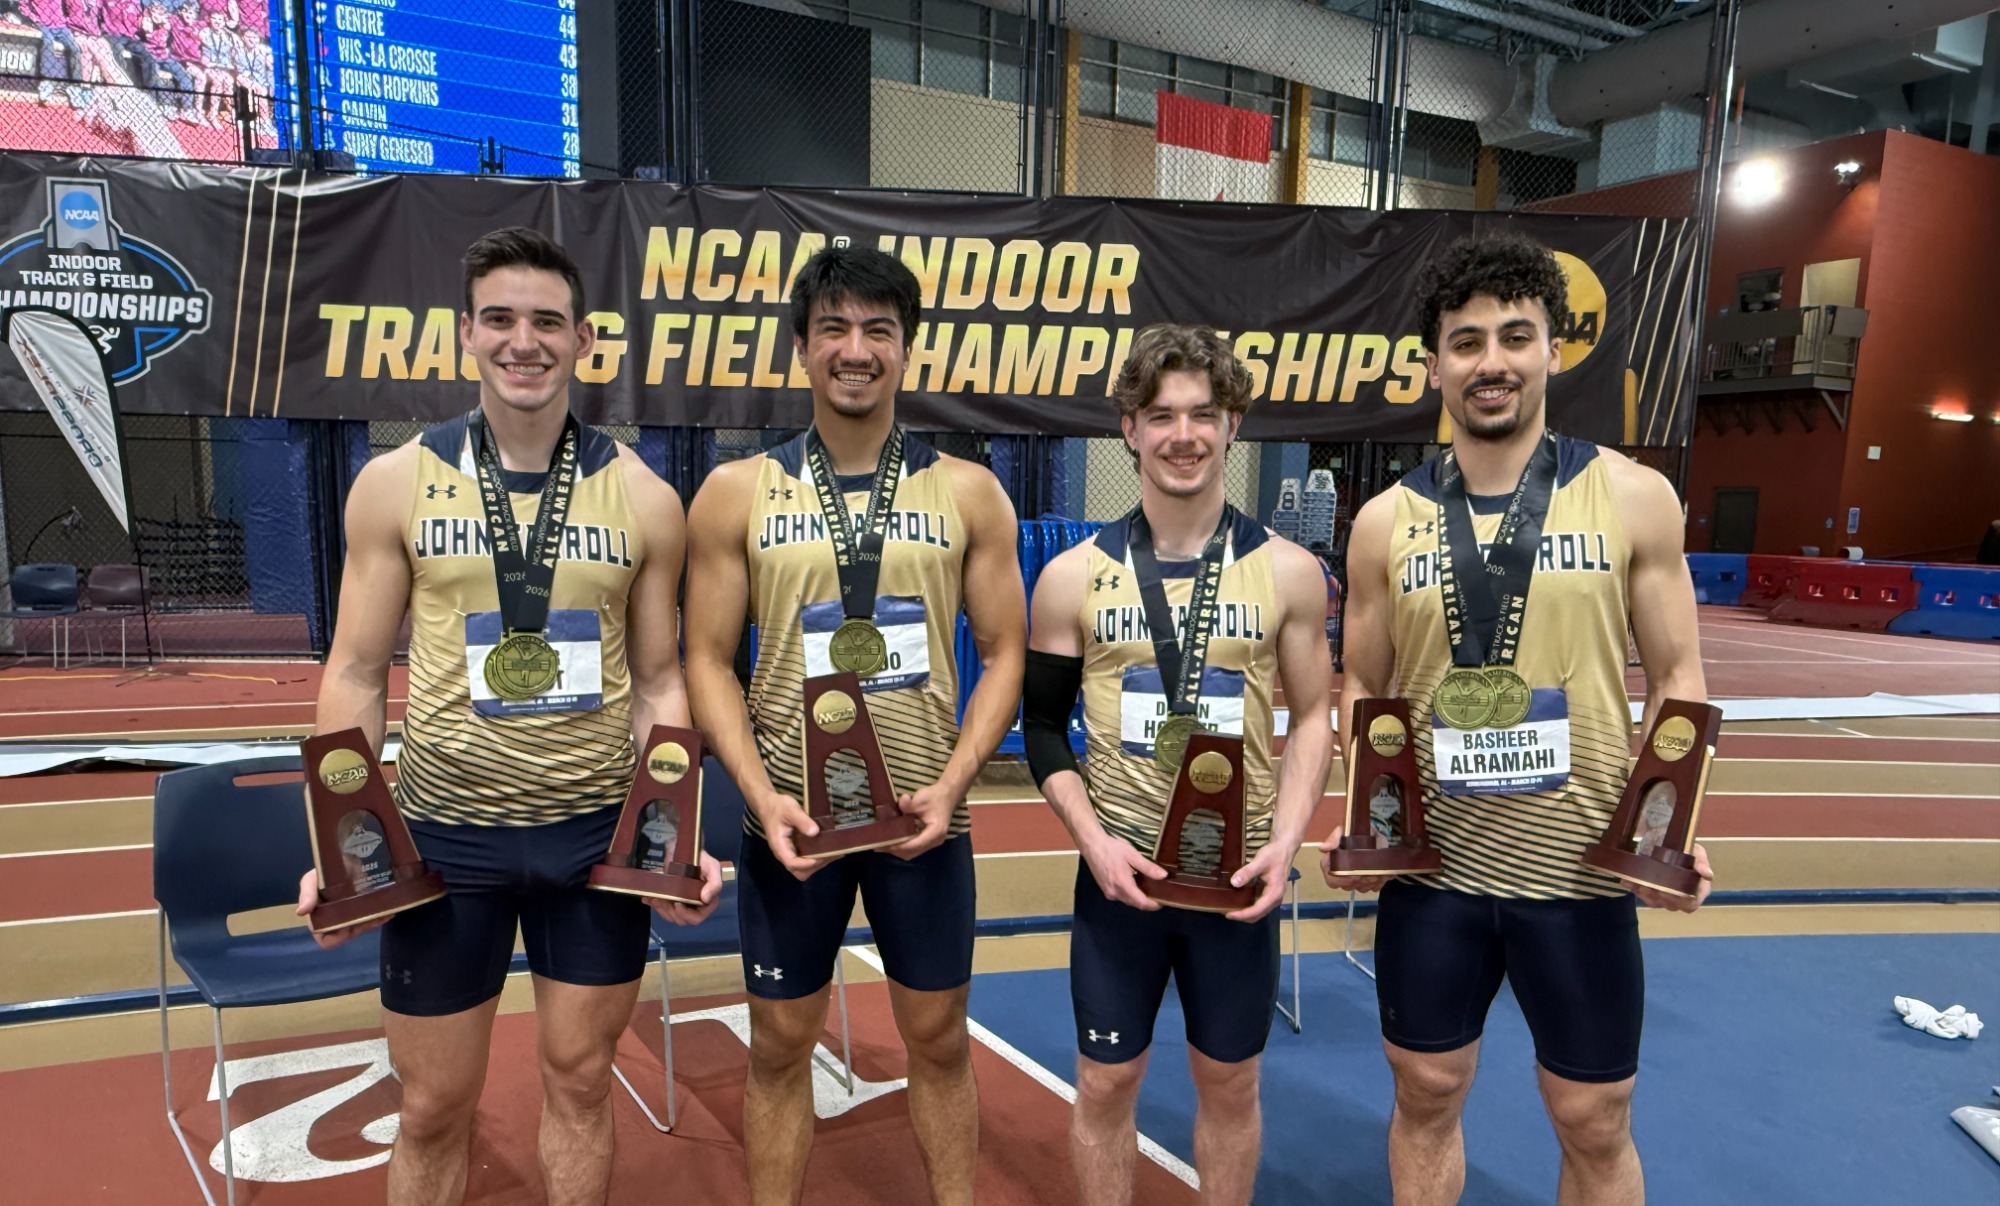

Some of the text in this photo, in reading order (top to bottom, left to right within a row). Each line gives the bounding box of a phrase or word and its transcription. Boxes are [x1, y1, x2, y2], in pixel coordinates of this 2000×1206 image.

[336, 4, 577, 40] CENTRE 44
[389, 44, 438, 76] CROSSE
[559, 43, 577, 69] 43
[339, 67, 578, 107] JOHNS HOPKINS 38
[342, 99, 578, 130] CALVIN 31
[342, 130, 580, 166] SUNY GENESEO 28
[65, 209, 99, 222] NCAA
[19, 270, 153, 289] TRACK & FIELD
[48, 254, 122, 272] INDOOR
[640, 226, 1140, 316] NCAA NDOOR
[0, 290, 204, 323] HAMPIONSHIPS
[1561, 312, 1599, 345] AA
[319, 303, 1428, 404] TRA & FIEL HAMPISHIPS
[479, 461, 510, 553] MERICAN
[809, 453, 850, 567] ALL-AMERICAN
[1282, 492, 1295, 510] 8
[414, 517, 633, 569] JOHN ROLL
[759, 510, 951, 551] JOHN AROLL
[859, 553, 880, 562] 2026
[1401, 550, 1441, 595] JOH
[525, 585, 550, 598] 2026
[1093, 602, 1264, 644] JOHN AROLL
[1185, 562, 1220, 704] ALL-AMERICAN
[1500, 596, 1525, 662] RICAN
[1463, 729, 1539, 750] BASHEER
[326, 767, 369, 787] NCAA
[1450, 748, 1556, 775] ALRAMAHI
